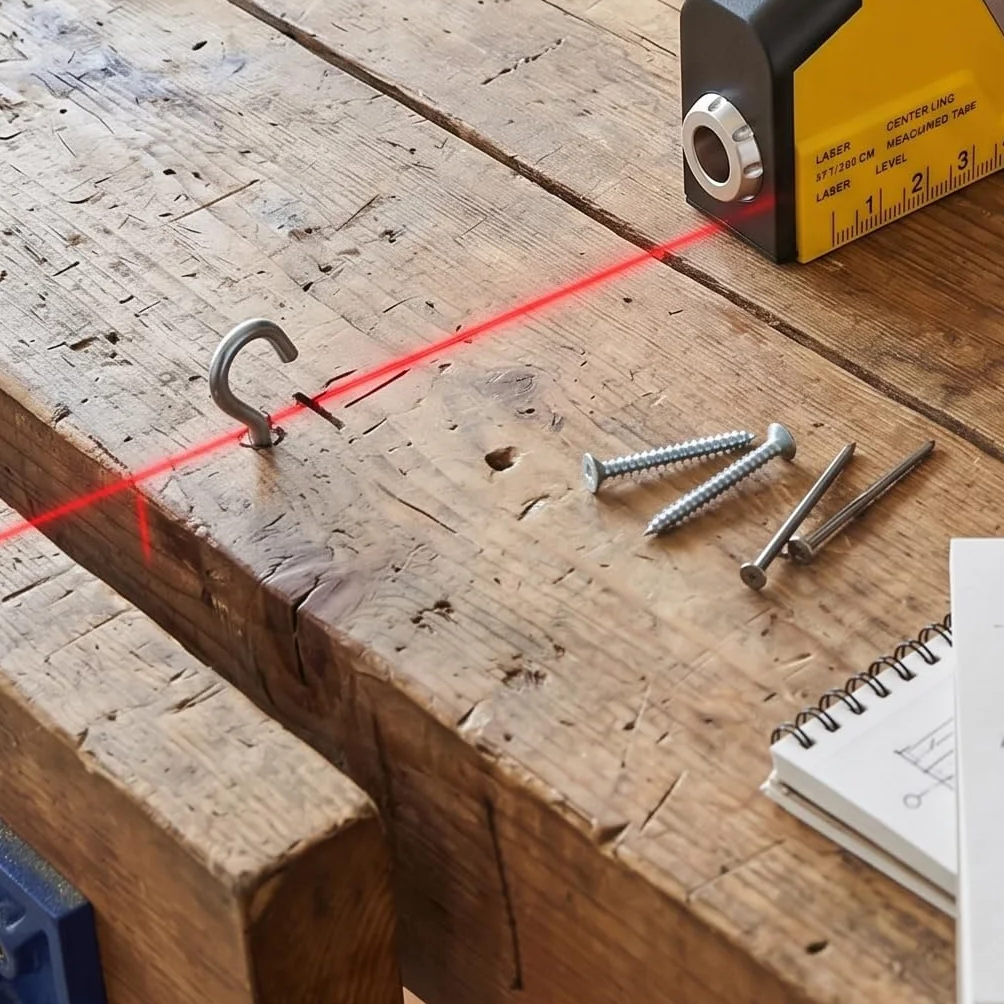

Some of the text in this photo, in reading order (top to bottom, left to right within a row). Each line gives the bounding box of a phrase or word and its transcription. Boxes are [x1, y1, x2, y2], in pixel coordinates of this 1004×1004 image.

[886, 105, 929, 132] CENTER
[858, 148, 875, 164] CM
[875, 153, 907, 175] LEVEL
[865, 195, 874, 214] 1
[911, 172, 923, 194] 2
[957, 150, 969, 171] 3
